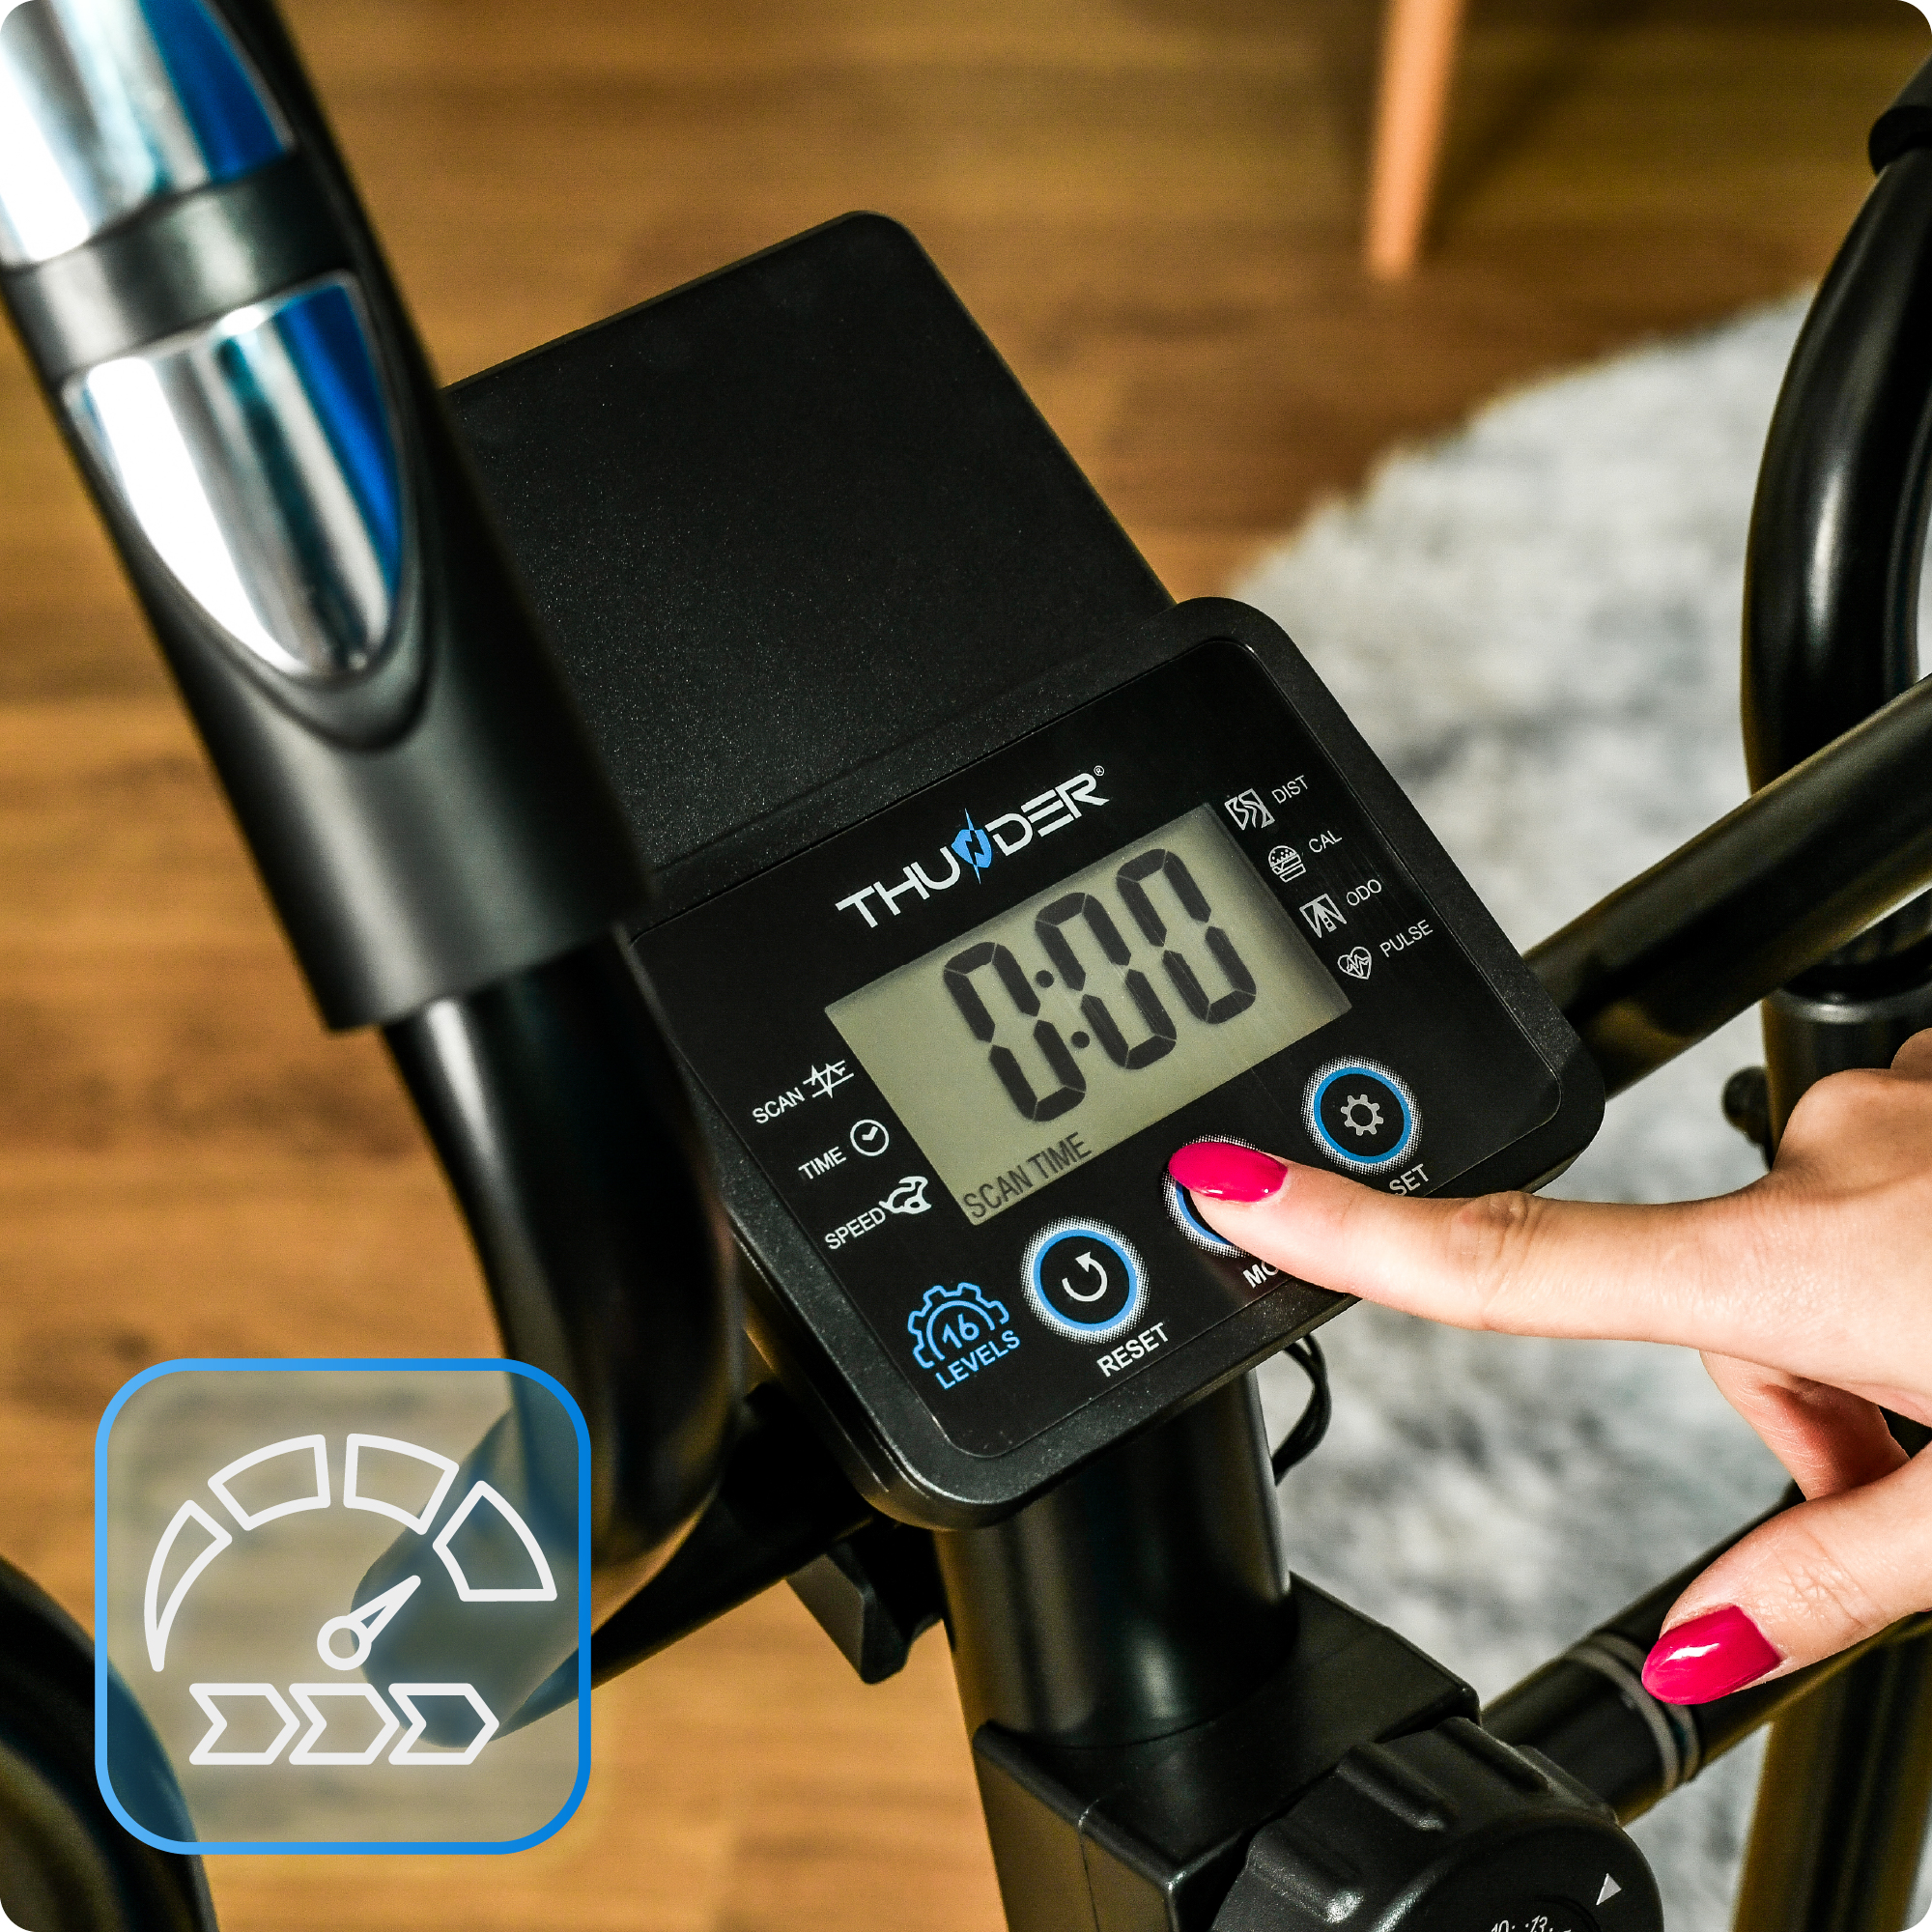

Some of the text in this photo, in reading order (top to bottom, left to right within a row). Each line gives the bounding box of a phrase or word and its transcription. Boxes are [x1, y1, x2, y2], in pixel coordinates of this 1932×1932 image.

[1271, 775, 1308, 804] DIST
[835, 772, 1110, 928] THUNDER
[1308, 830, 1343, 853] CAL
[1346, 879, 1382, 906] ODO
[1379, 920, 1434, 957] PULSE
[943, 848, 1256, 1122] 0:00
[753, 1087, 806, 1123] SCAN
[798, 1146, 847, 1179] TIME
[963, 1131, 1093, 1218] SCAN TIME
[1389, 1163, 1430, 1196] SET
[825, 1208, 886, 1249] SPEED
[1242, 1260, 1279, 1289] MO
[942, 1313, 980, 1349] 16
[935, 1329, 1021, 1389] LEVELS
[1096, 1321, 1170, 1378] RESET
